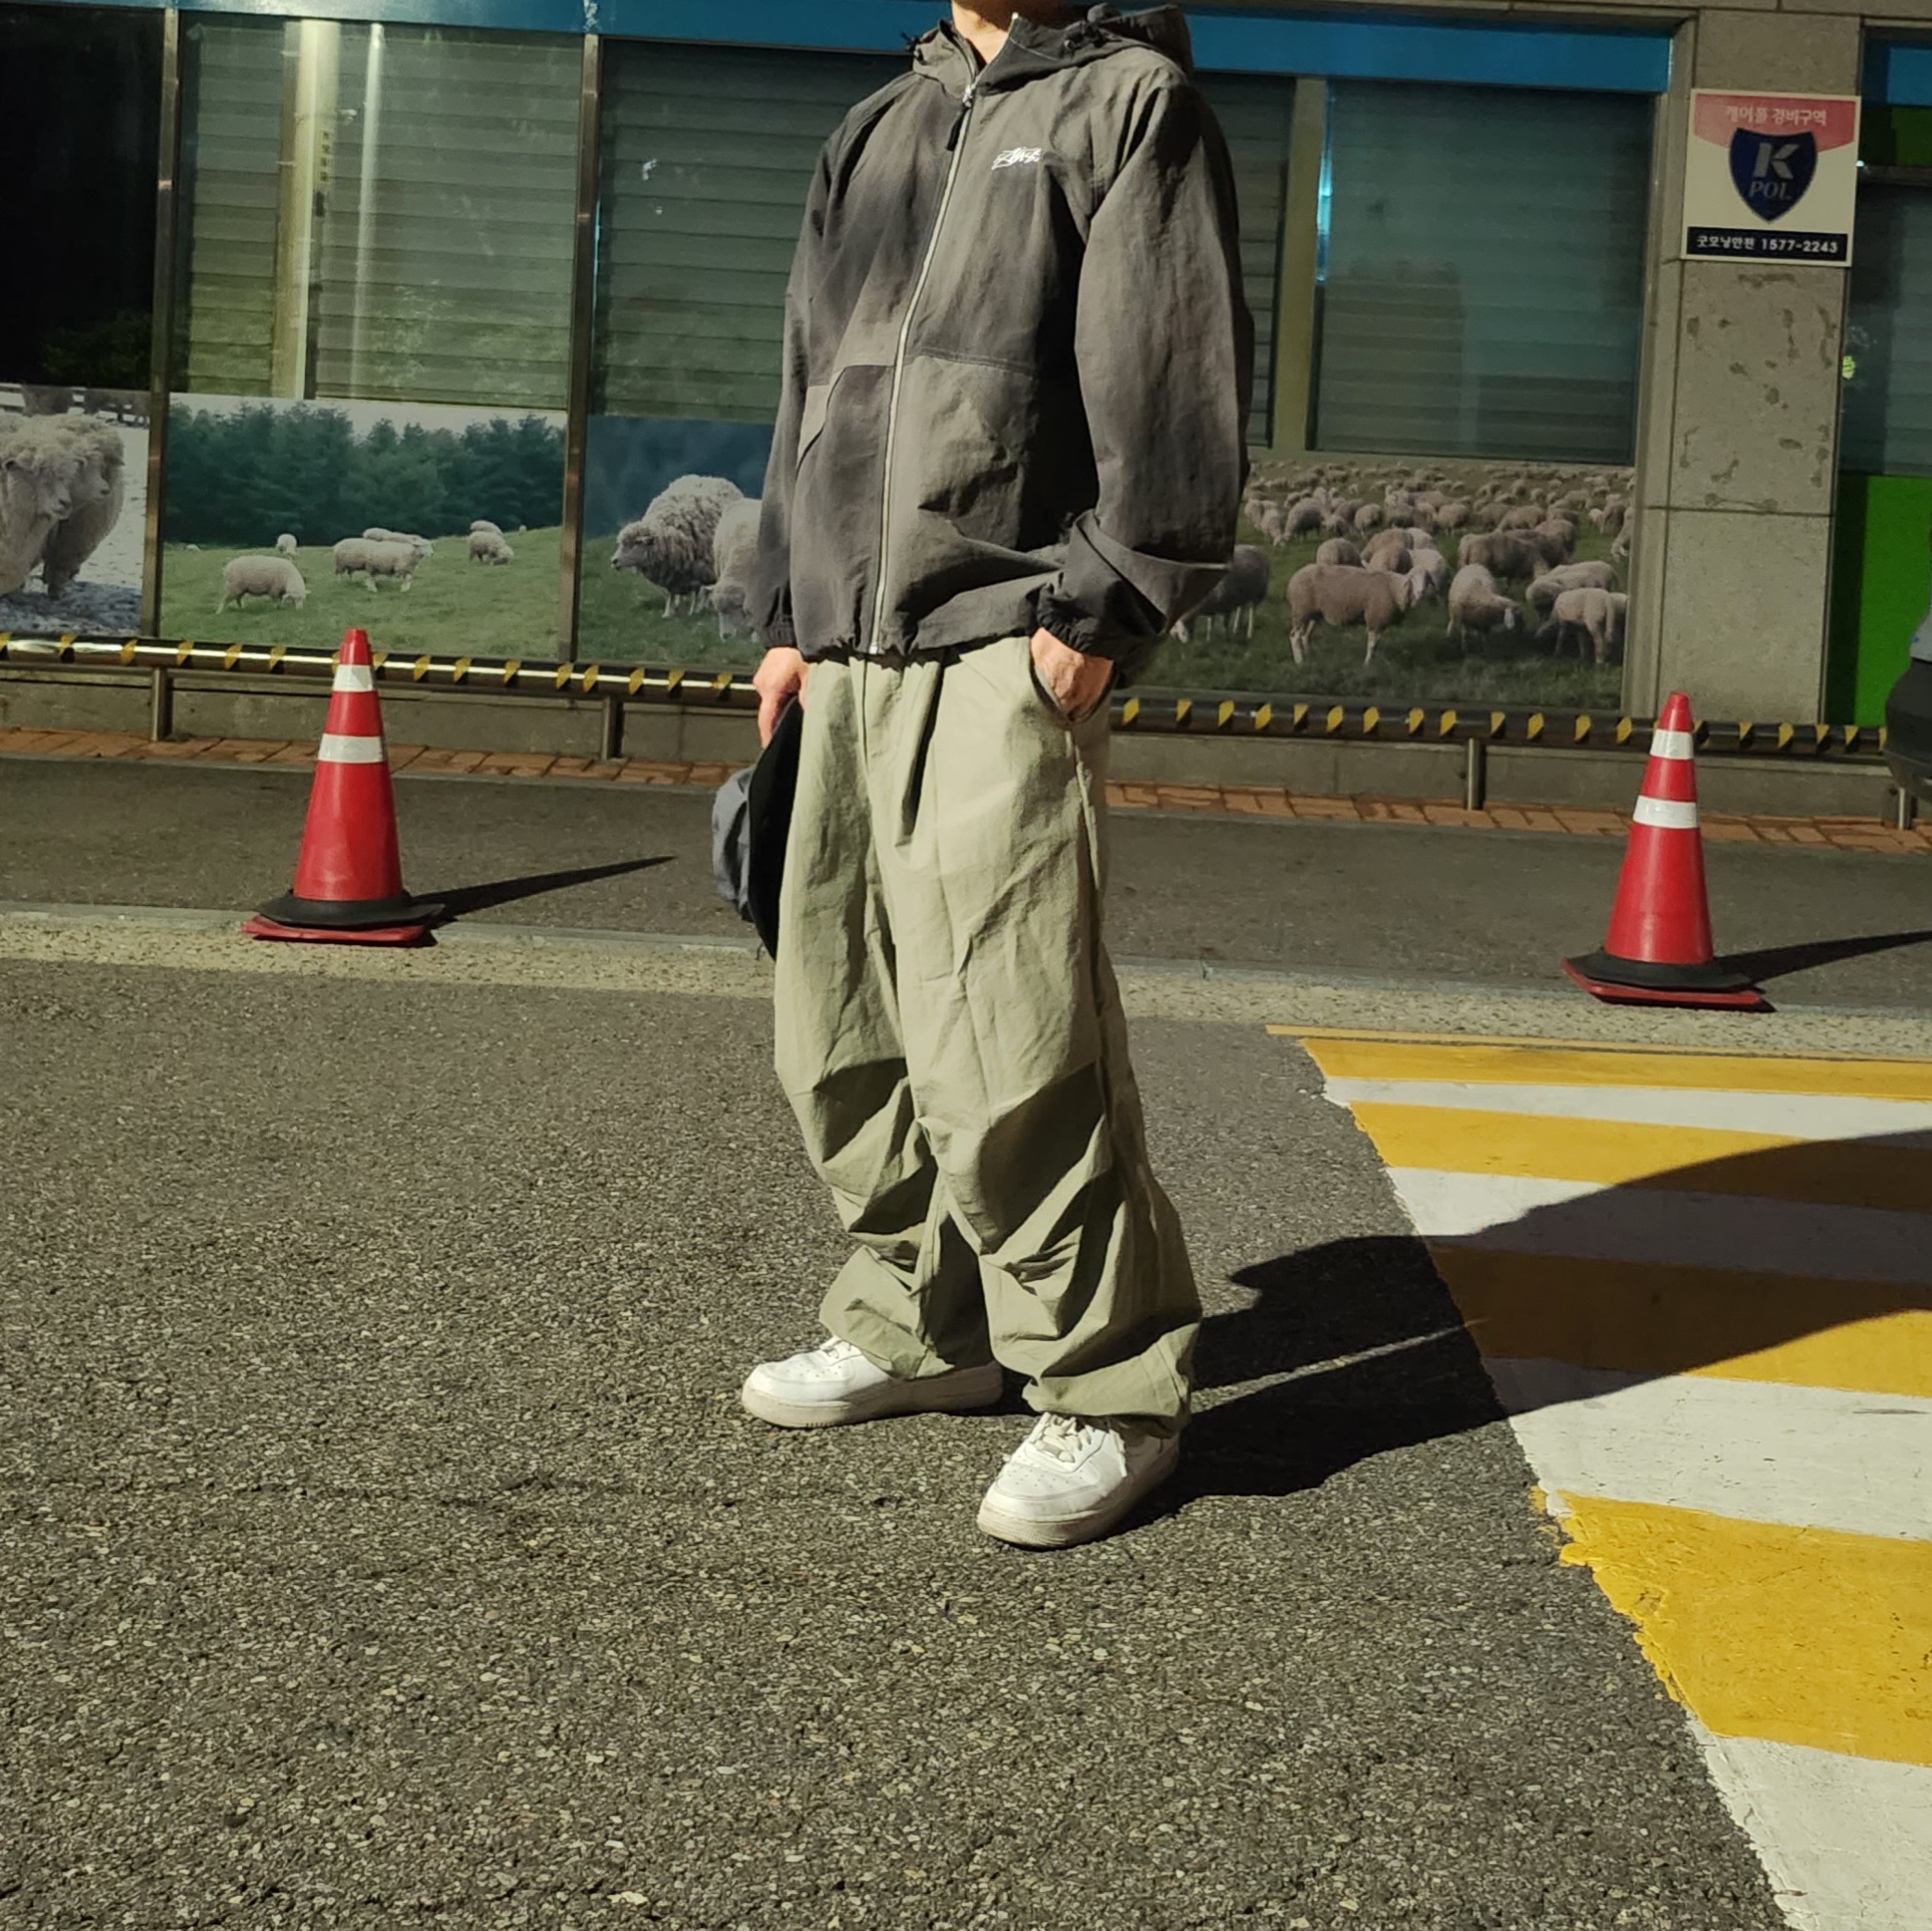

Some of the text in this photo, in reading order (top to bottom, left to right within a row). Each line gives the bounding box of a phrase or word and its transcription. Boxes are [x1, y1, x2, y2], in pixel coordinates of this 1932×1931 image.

[1753, 142, 1799, 179] K
[1748, 181, 1792, 199] POL
[1760, 238, 1839, 253] 1577-2243
